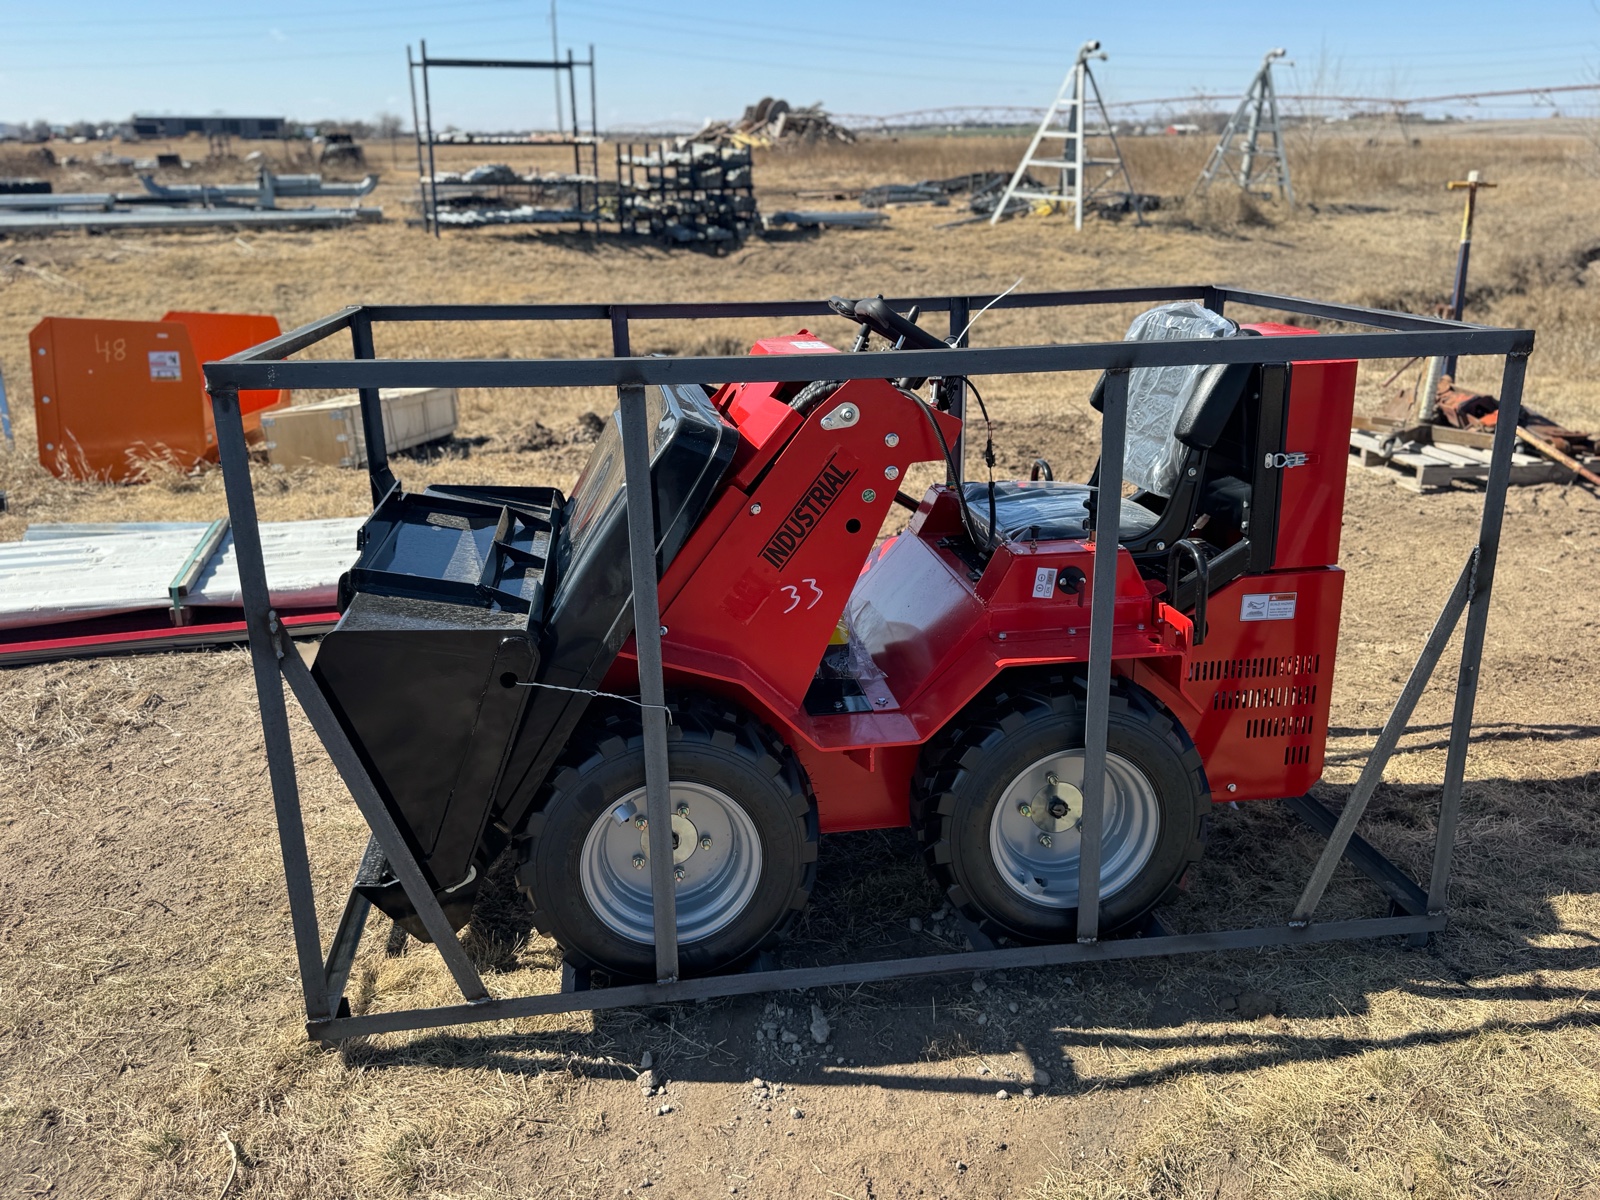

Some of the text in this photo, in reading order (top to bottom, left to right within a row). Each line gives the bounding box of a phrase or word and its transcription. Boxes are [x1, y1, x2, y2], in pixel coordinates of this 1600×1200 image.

[95, 334, 126, 363] 48
[762, 463, 851, 569] INDUSTRIAL
[781, 578, 823, 614] 33
